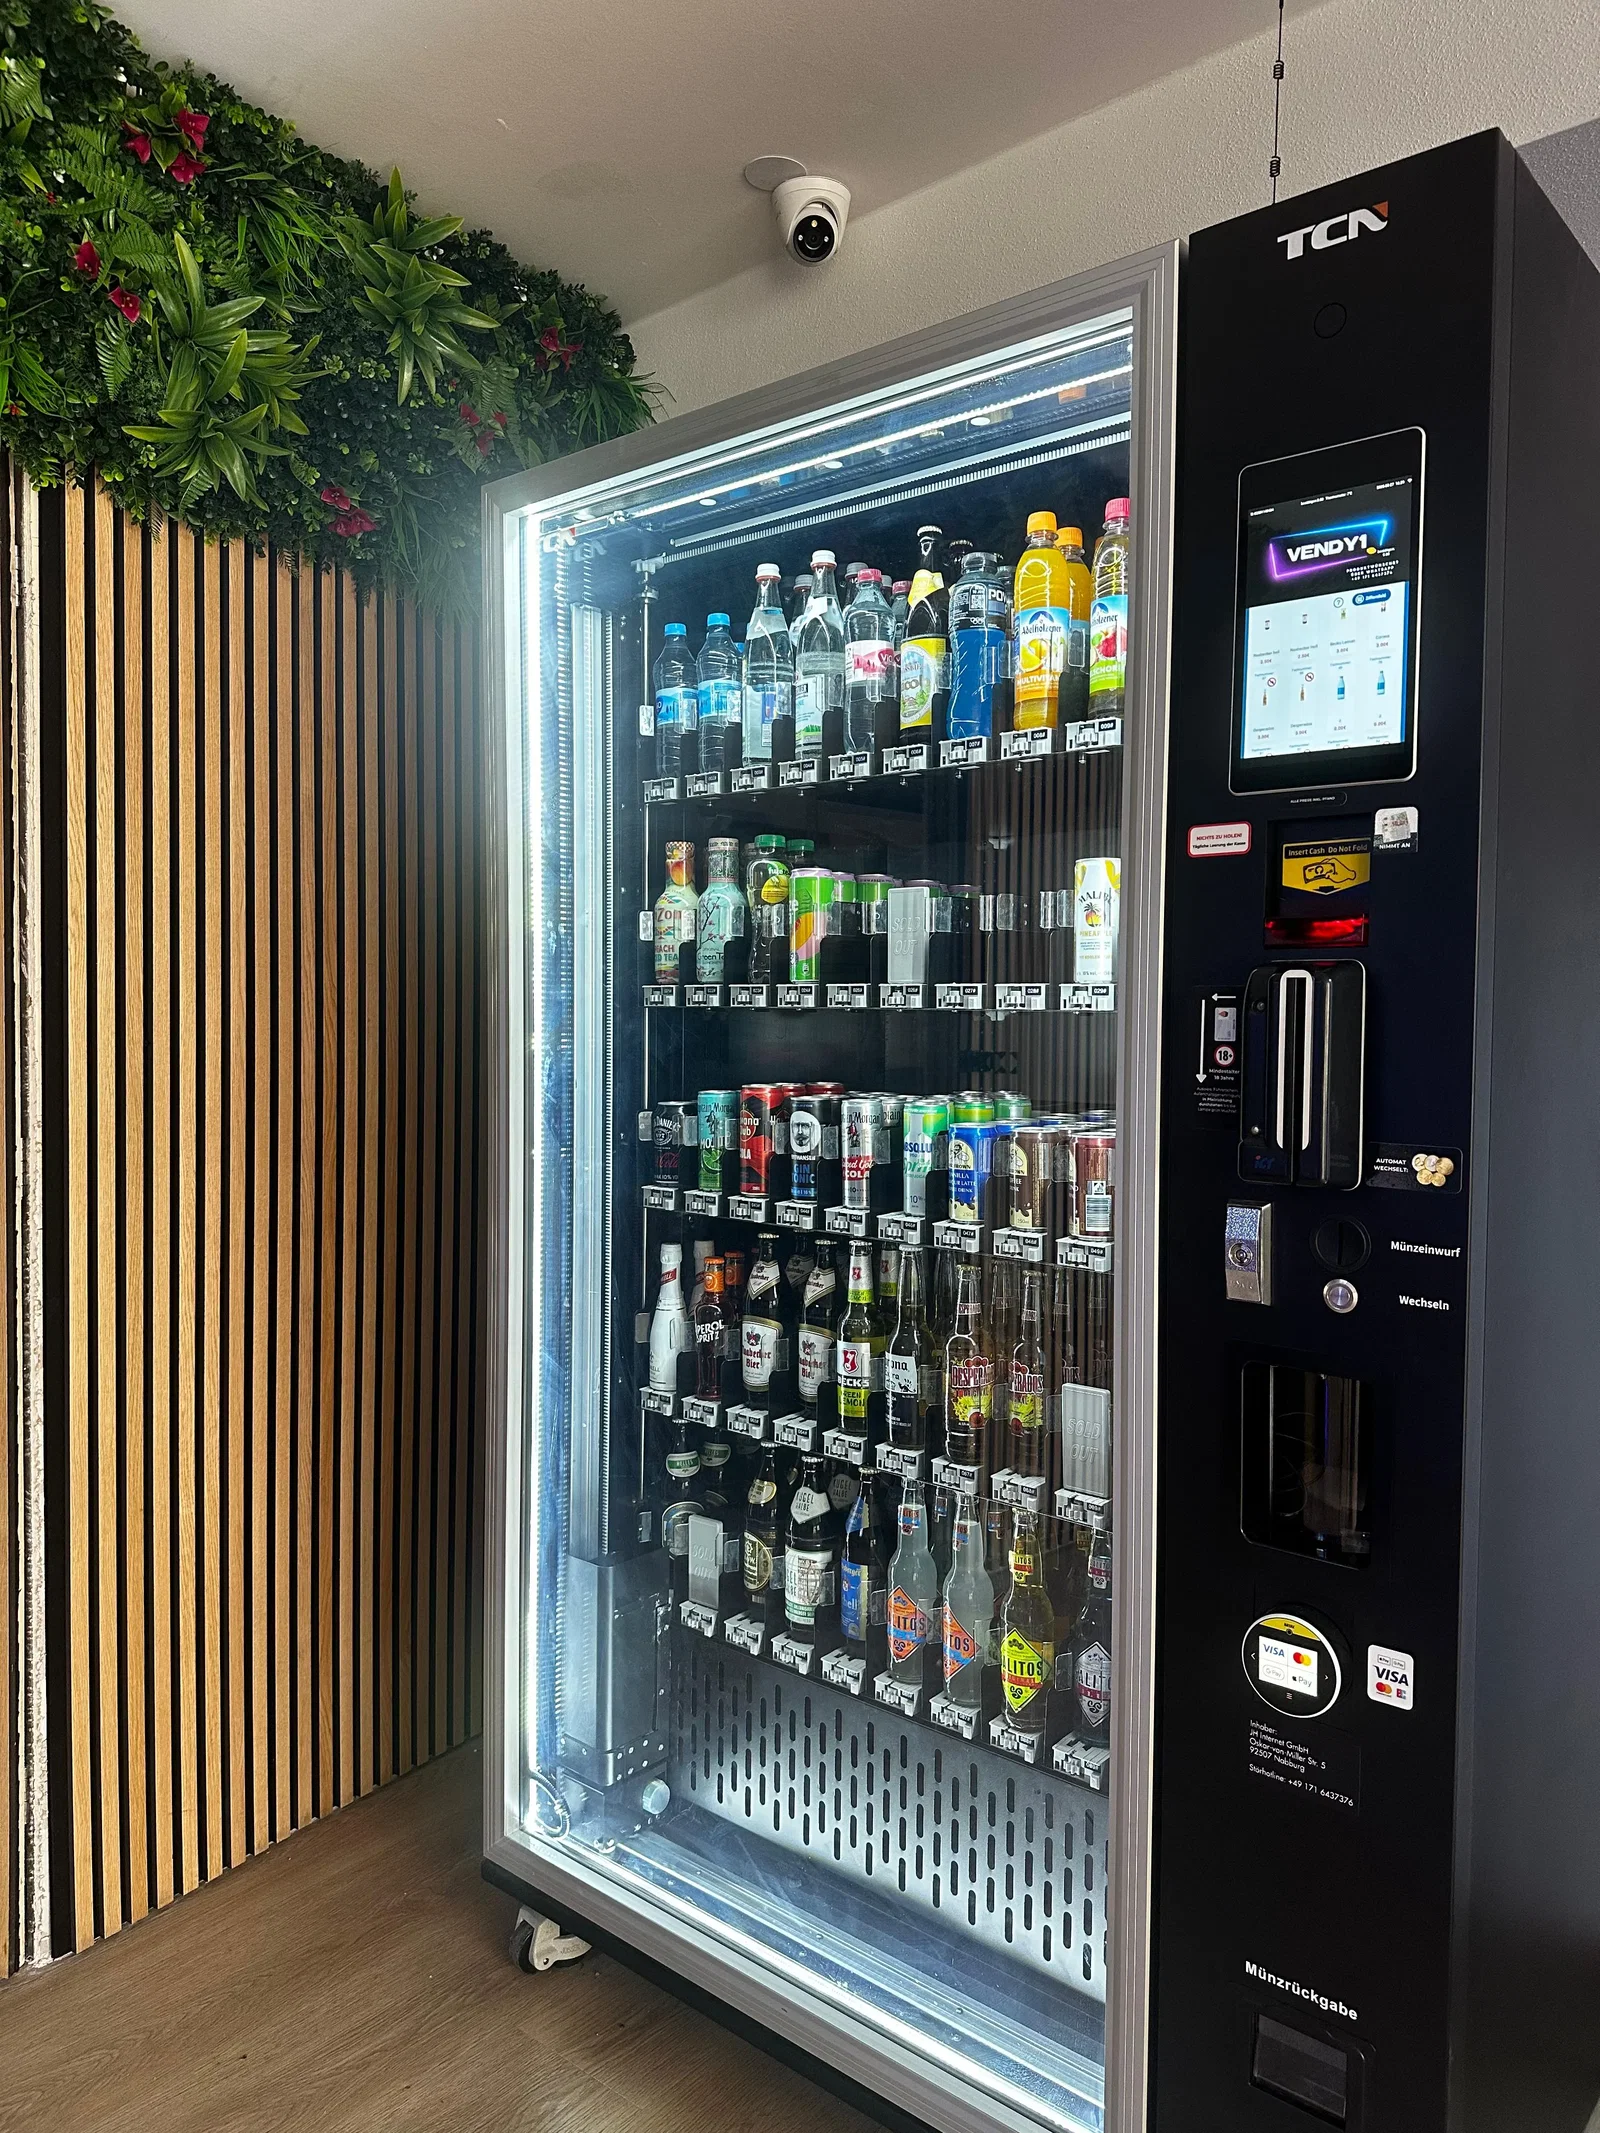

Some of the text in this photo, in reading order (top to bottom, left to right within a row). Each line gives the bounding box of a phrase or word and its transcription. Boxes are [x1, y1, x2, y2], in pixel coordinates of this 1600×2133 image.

[1277, 201, 1388, 260] TCN
[1287, 534, 1367, 562] VENDY1
[1288, 848, 1308, 856] Insert
[1309, 847, 1325, 855] Cash
[1352, 844, 1367, 852] Fold
[891, 916, 921, 932] SOLD
[893, 940, 917, 956] OUT
[664, 953, 678, 961] TEA
[1218, 1051, 1232, 1061] 18+
[794, 1164, 810, 1173] GIN
[1376, 1158, 1407, 1166] AUTOMAT
[1391, 1241, 1461, 1257] Münzeinwurf
[1399, 1295, 1449, 1310] Wechseln
[746, 1359, 760, 1369] Bier
[1067, 1418, 1101, 1440] SOLD
[1070, 1444, 1099, 1464] OUT
[1263, 1644, 1284, 1658] VISA
[1298, 1675, 1312, 1688] Pay
[1373, 1664, 1409, 1687] VISA
[1250, 1720, 1277, 1735] Inhaber:
[1260, 1732, 1284, 1746] Internet
[1286, 1741, 1308, 1754] GmbH
[1250, 1746, 1305, 1773] 92507 Nabburg
[1288, 1780, 1302, 1788] +49
[1305, 1783, 1317, 1794] 171
[1320, 1789, 1354, 1806] 6437376
[1245, 1961, 1358, 2020] Münzrückgabe
